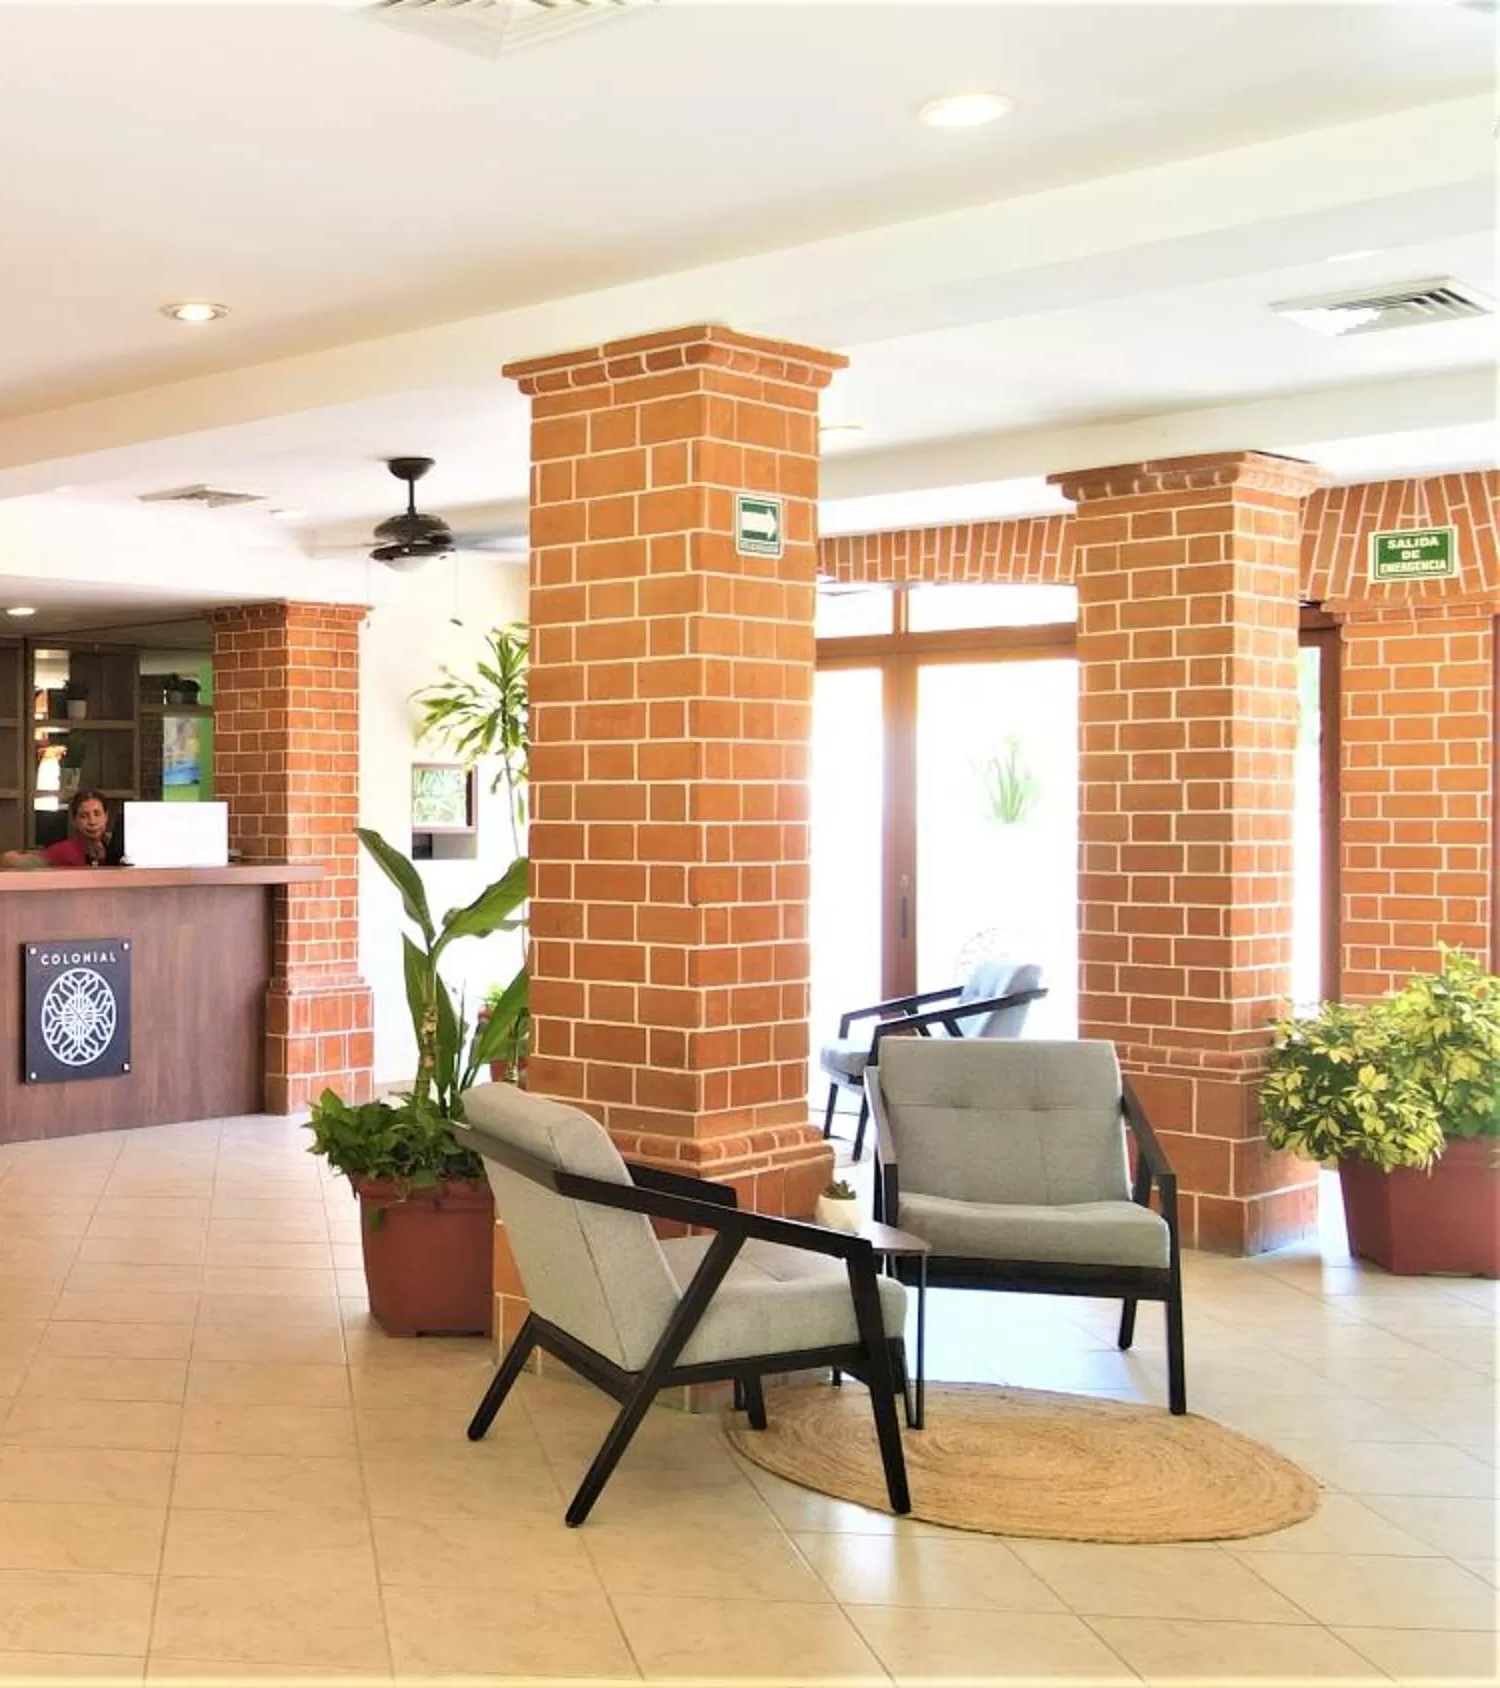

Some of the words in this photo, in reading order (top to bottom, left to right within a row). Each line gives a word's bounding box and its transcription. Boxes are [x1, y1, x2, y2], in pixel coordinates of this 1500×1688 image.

[1387, 536, 1439, 550] SALIDA
[1401, 549, 1421, 560] DE
[41, 951, 117, 966] COLONIAL
